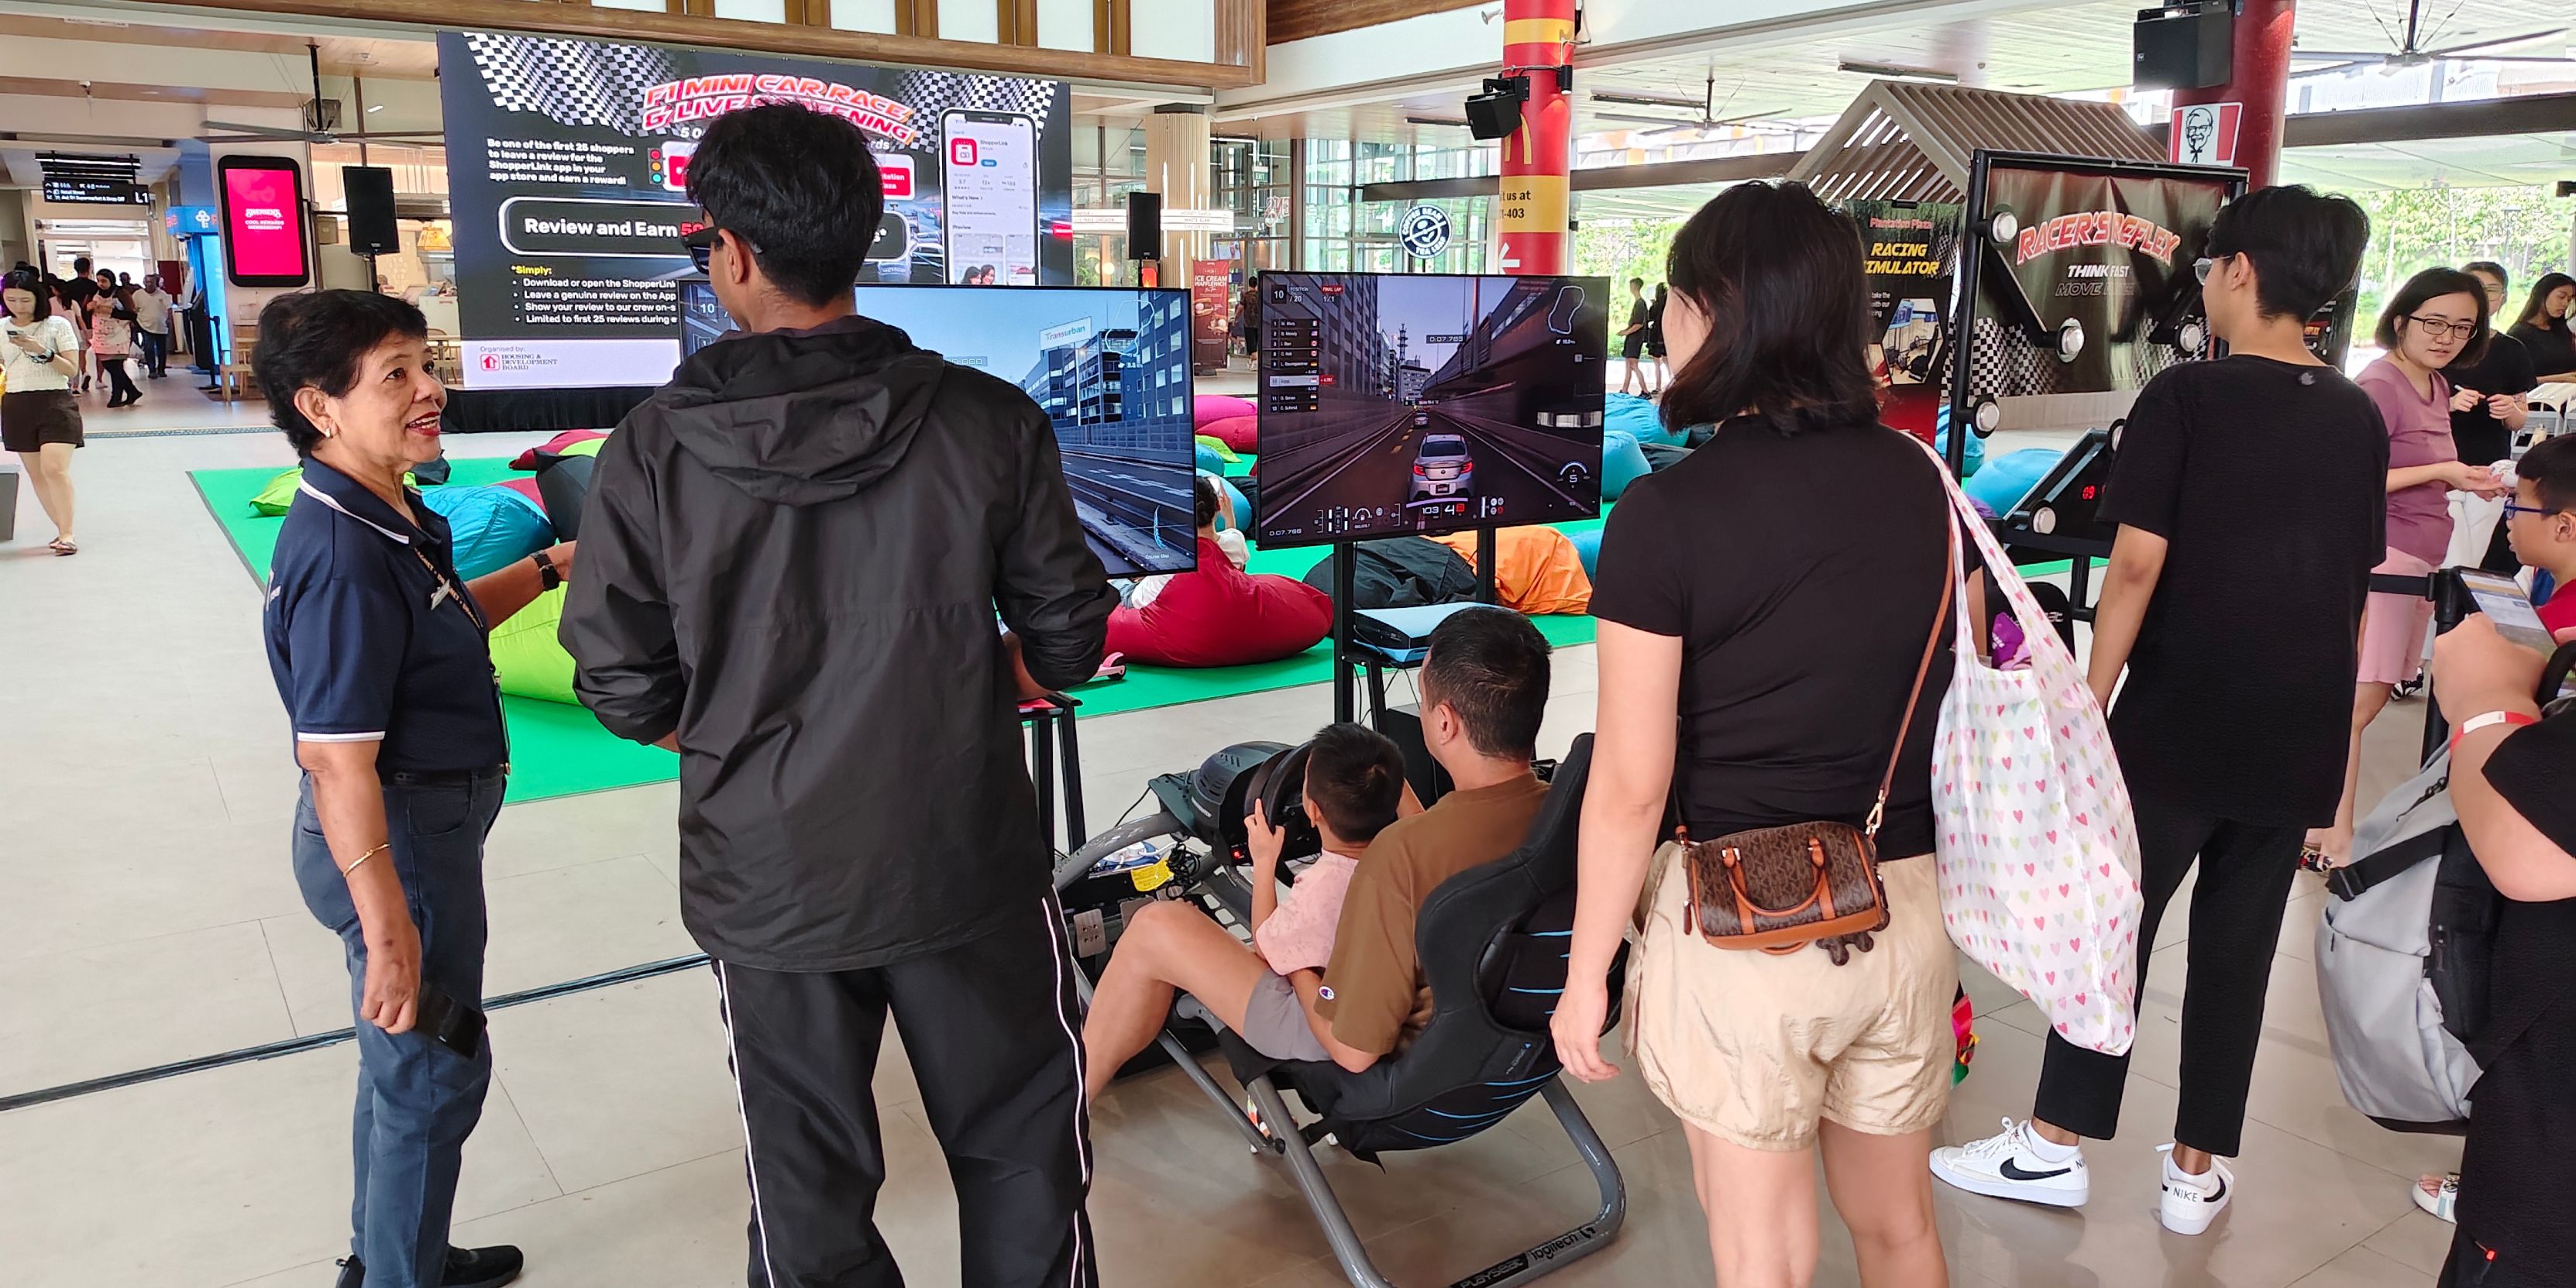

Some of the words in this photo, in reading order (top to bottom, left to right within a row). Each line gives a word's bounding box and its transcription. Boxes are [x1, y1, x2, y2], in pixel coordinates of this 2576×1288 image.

[683, 74, 755, 98] MINI
[755, 74, 827, 98] CAR
[827, 83, 914, 123] RACE
[673, 94, 751, 123] LIVE
[487, 139, 501, 147] Be
[502, 140, 521, 149] one
[522, 140, 534, 149] of
[535, 140, 552, 149] the
[553, 141, 575, 150] first
[576, 143, 589, 152] 25
[590, 143, 635, 155] shoppers
[488, 149, 500, 158] to
[500, 149, 528, 160] leave
[536, 152, 569, 161] review
[570, 153, 586, 162] for
[586, 154, 603, 163] the
[489, 160, 552, 171] ShopperLink
[553, 164, 572, 173] app
[573, 163, 583, 173] in
[583, 166, 606, 174] your
[490, 172, 509, 181] app
[510, 171, 538, 181] store
[538, 173, 558, 182] and
[590, 177, 627, 185] reward!
[135, 191, 149, 203] L1
[1506, 192, 1517, 201] us
[1519, 191, 1531, 201] at
[524, 218, 593, 234] Review
[597, 222, 632, 236] and
[635, 222, 679, 237] Earn
[2017, 211, 2113, 266] RACER'S
[2110, 211, 2181, 267] REFLEX
[1870, 242, 1929, 257] RACING
[1863, 260, 1941, 275] IMULATOR
[2068, 265, 2109, 277] THINK
[2109, 266, 2130, 277] FAST
[523, 278, 569, 287] Download
[581, 280, 604, 289] open
[605, 279, 621, 288] the
[2055, 282, 2103, 296] MOVE
[524, 290, 552, 299] Leave
[561, 291, 598, 301] genuine
[599, 291, 628, 300] review
[659, 292, 676, 301] App
[1274, 290, 1285, 299] 10
[525, 302, 552, 311] Show
[552, 304, 573, 313] your
[575, 303, 604, 311] review
[700, 303, 714, 313] 10
[526, 314, 561, 323] Limited
[562, 314, 573, 323] to
[573, 314, 592, 323] first
[641, 315, 670, 325] during
[1046, 324, 1086, 342] Transurban
[1444, 505, 1455, 516] 4
[2172, 1187, 2198, 1202] NIKE
